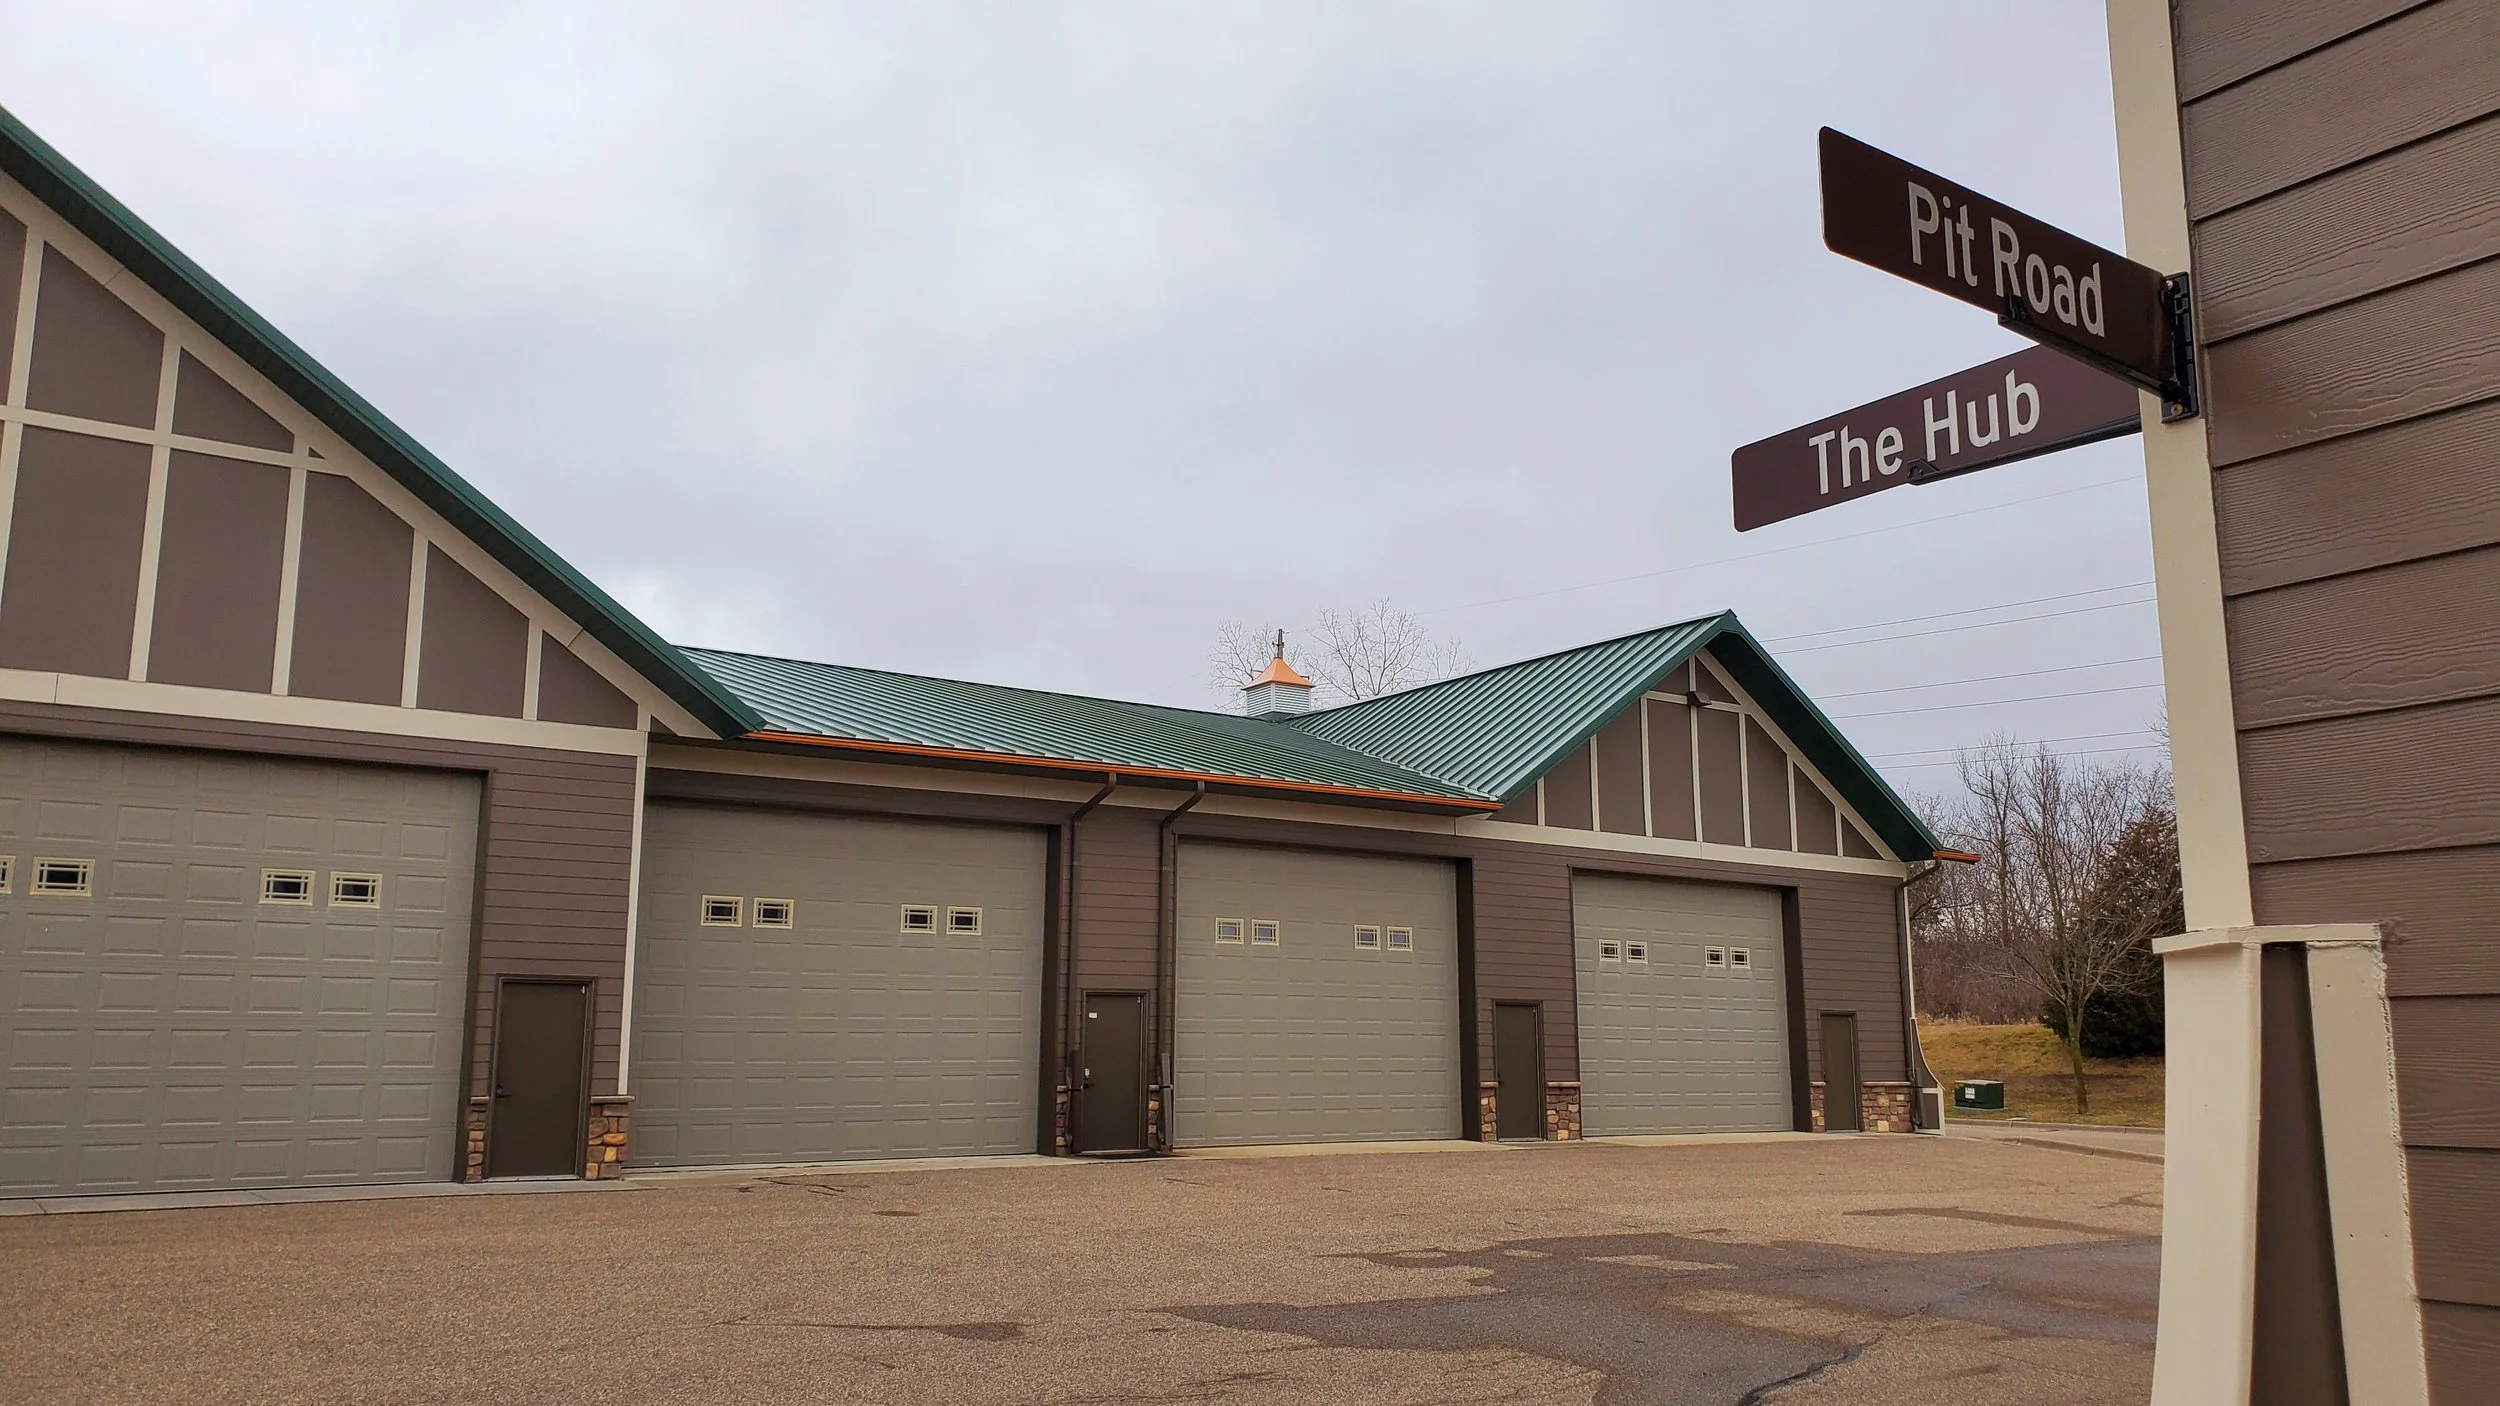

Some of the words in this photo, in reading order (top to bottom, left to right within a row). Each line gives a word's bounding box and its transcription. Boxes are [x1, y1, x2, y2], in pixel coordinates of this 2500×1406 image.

[1908, 181, 1978, 287] Pit
[1991, 217, 2105, 337] Road
[1808, 425, 1904, 495] The
[1923, 369, 2040, 462] Hub
